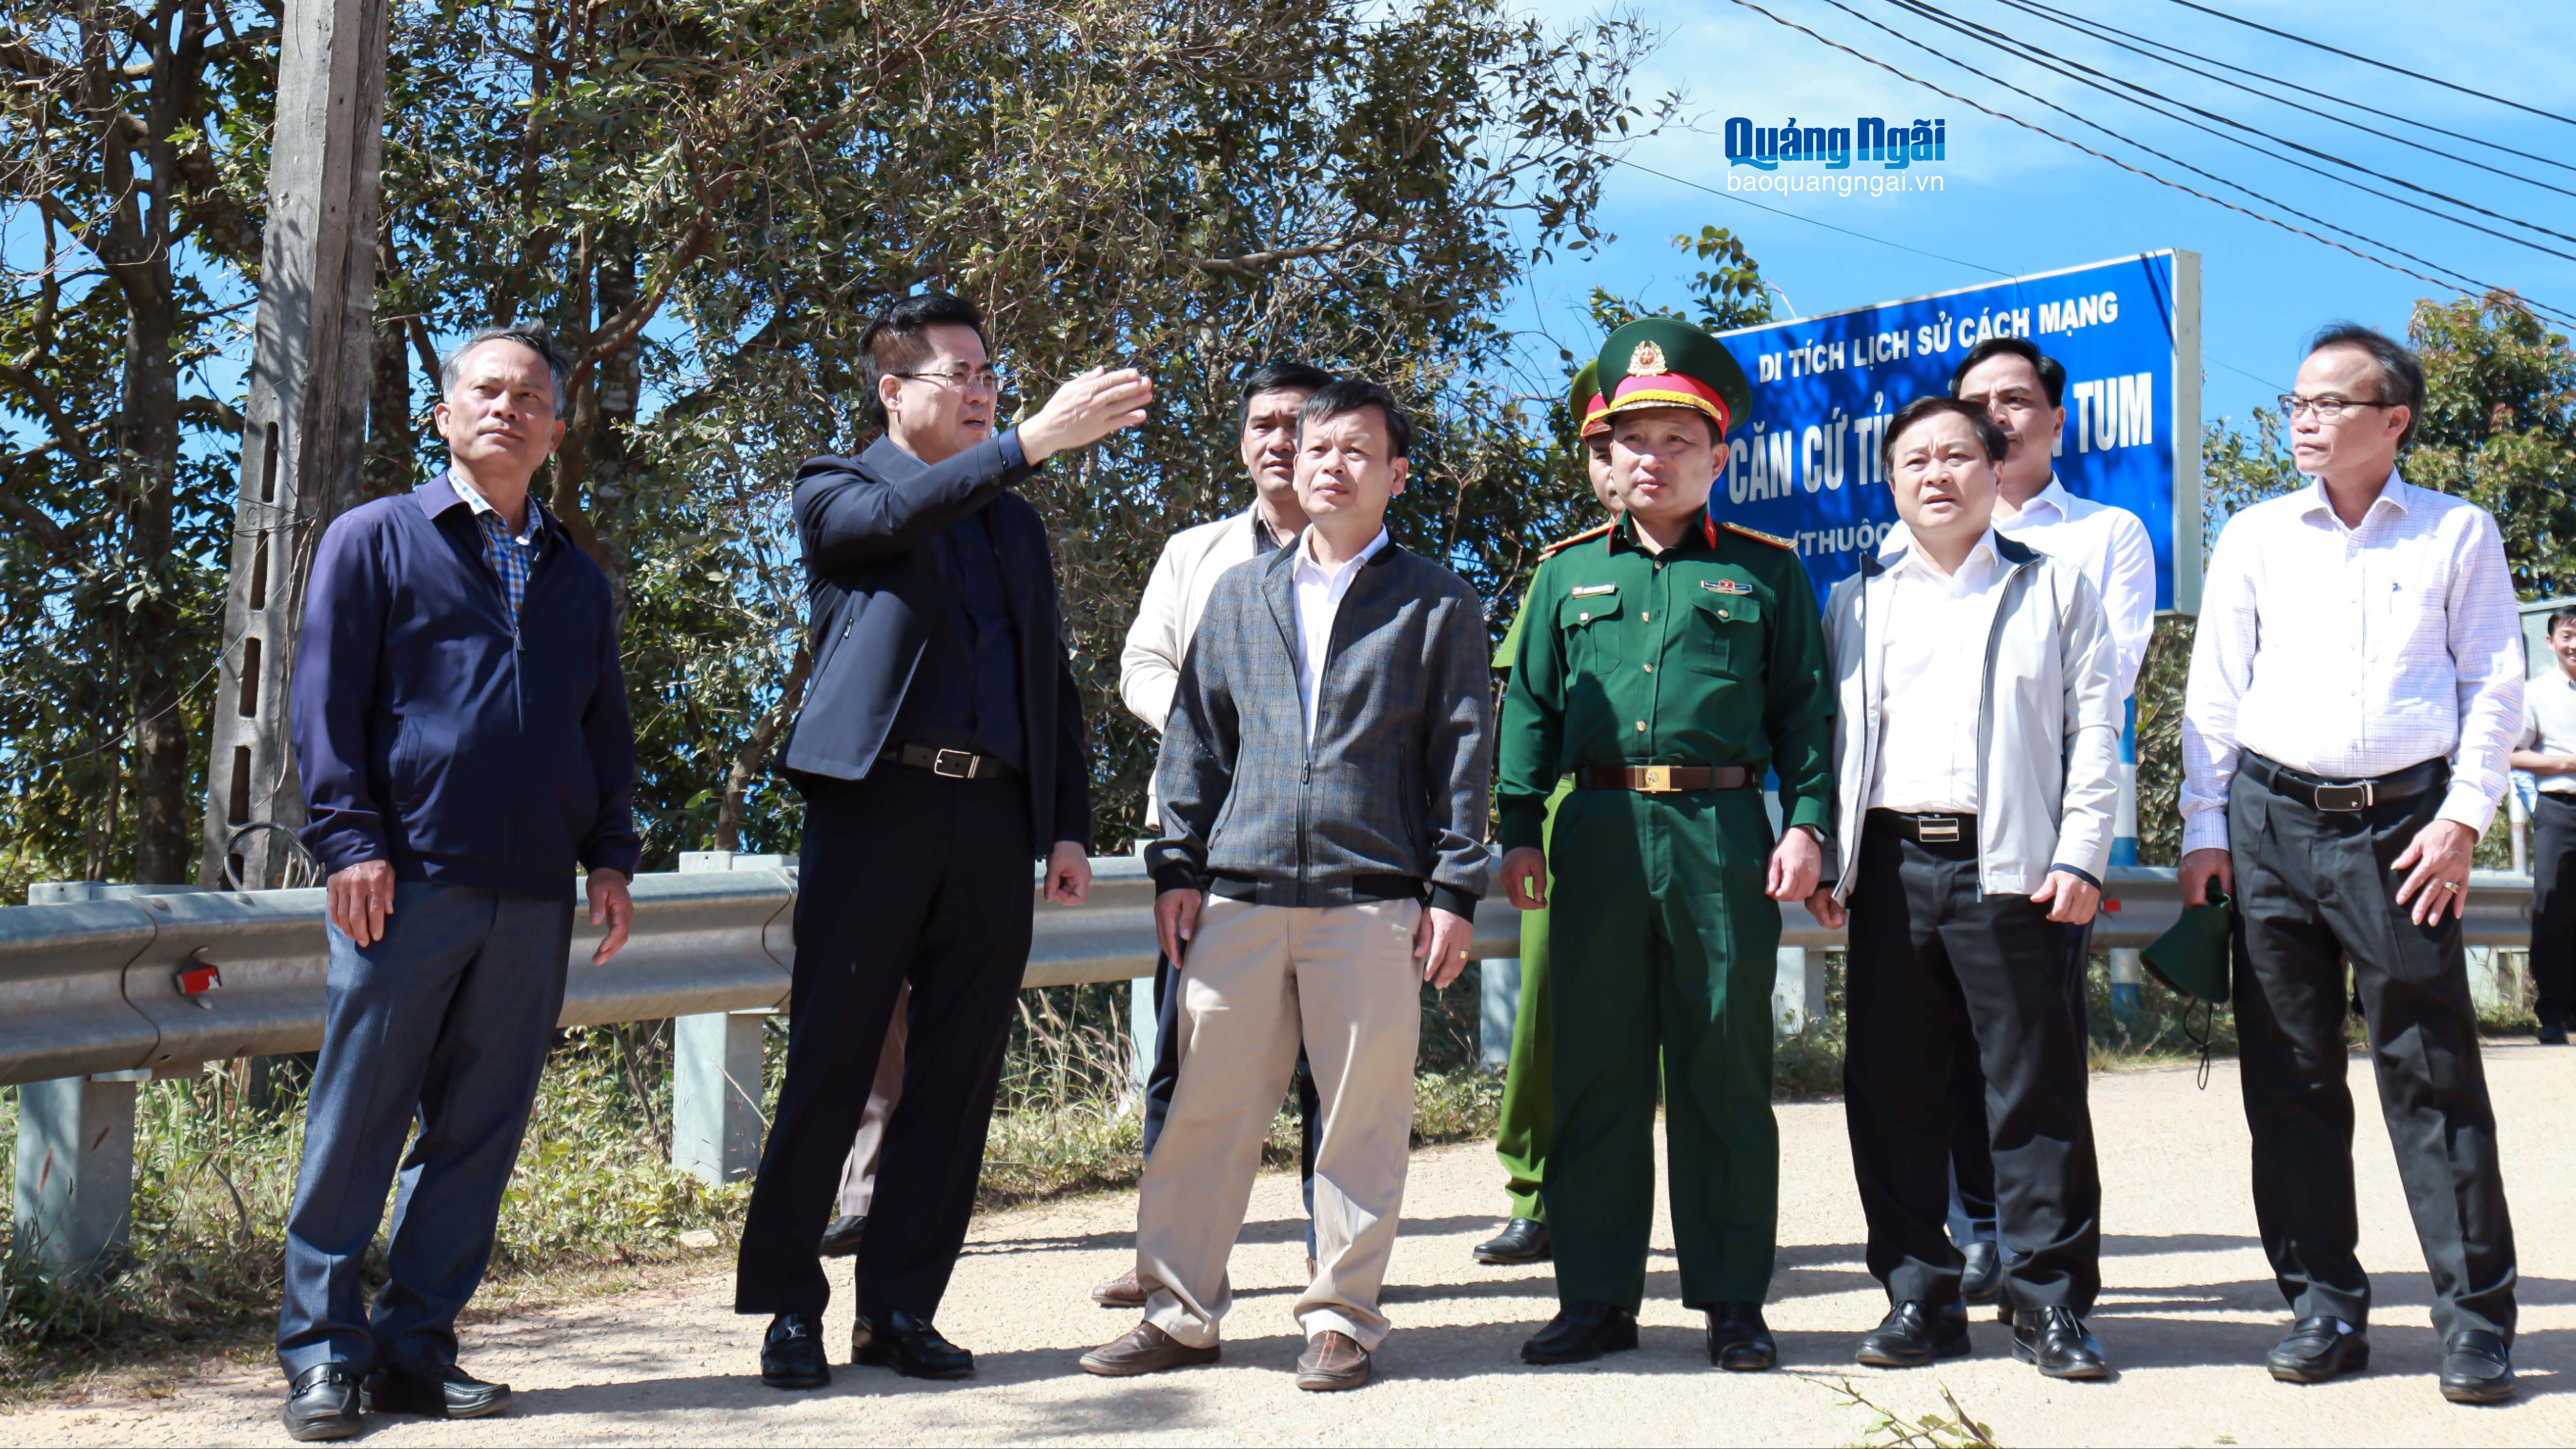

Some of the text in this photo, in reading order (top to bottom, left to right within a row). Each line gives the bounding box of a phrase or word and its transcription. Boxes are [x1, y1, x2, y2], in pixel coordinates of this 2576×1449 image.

[1759, 292, 2118, 383] DI TÍCH LỊCH SỬ CÁCH MẠNG
[1729, 421, 1792, 505] CĂN
[1802, 408, 1848, 493] CỨ
[2073, 372, 2152, 454] TUM
